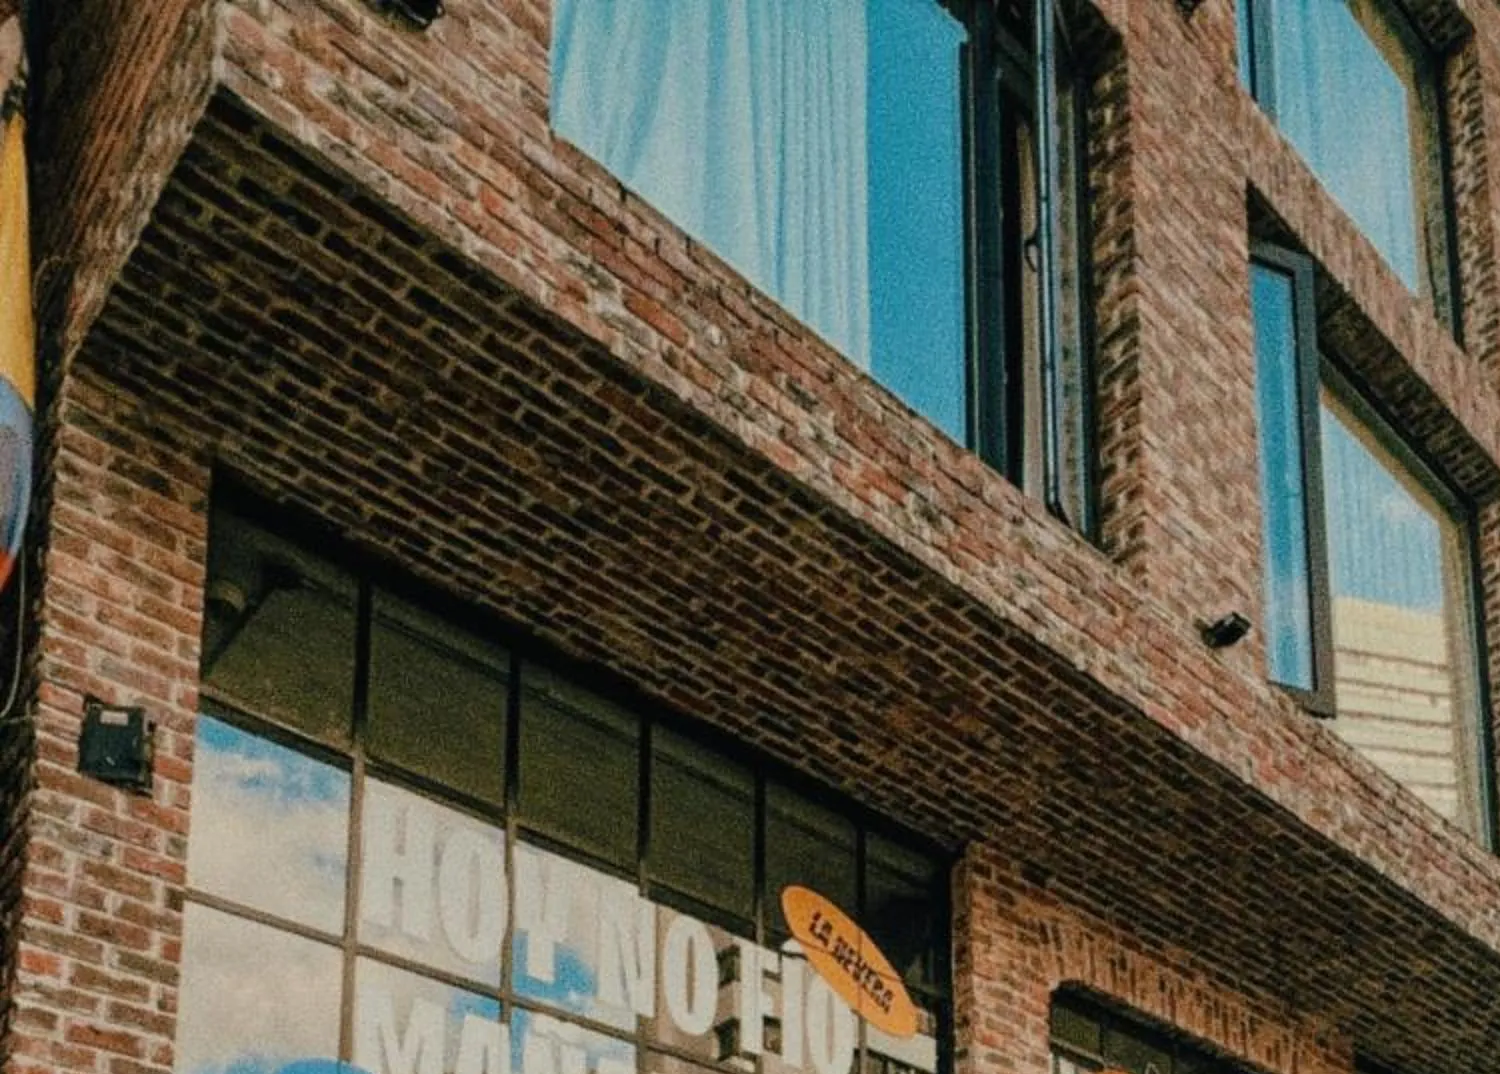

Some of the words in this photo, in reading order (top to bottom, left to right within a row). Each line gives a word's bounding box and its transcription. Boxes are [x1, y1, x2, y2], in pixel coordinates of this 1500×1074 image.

[363, 792, 578, 982] HOY
[597, 880, 720, 1037] NO
[809, 911, 834, 948] LA
